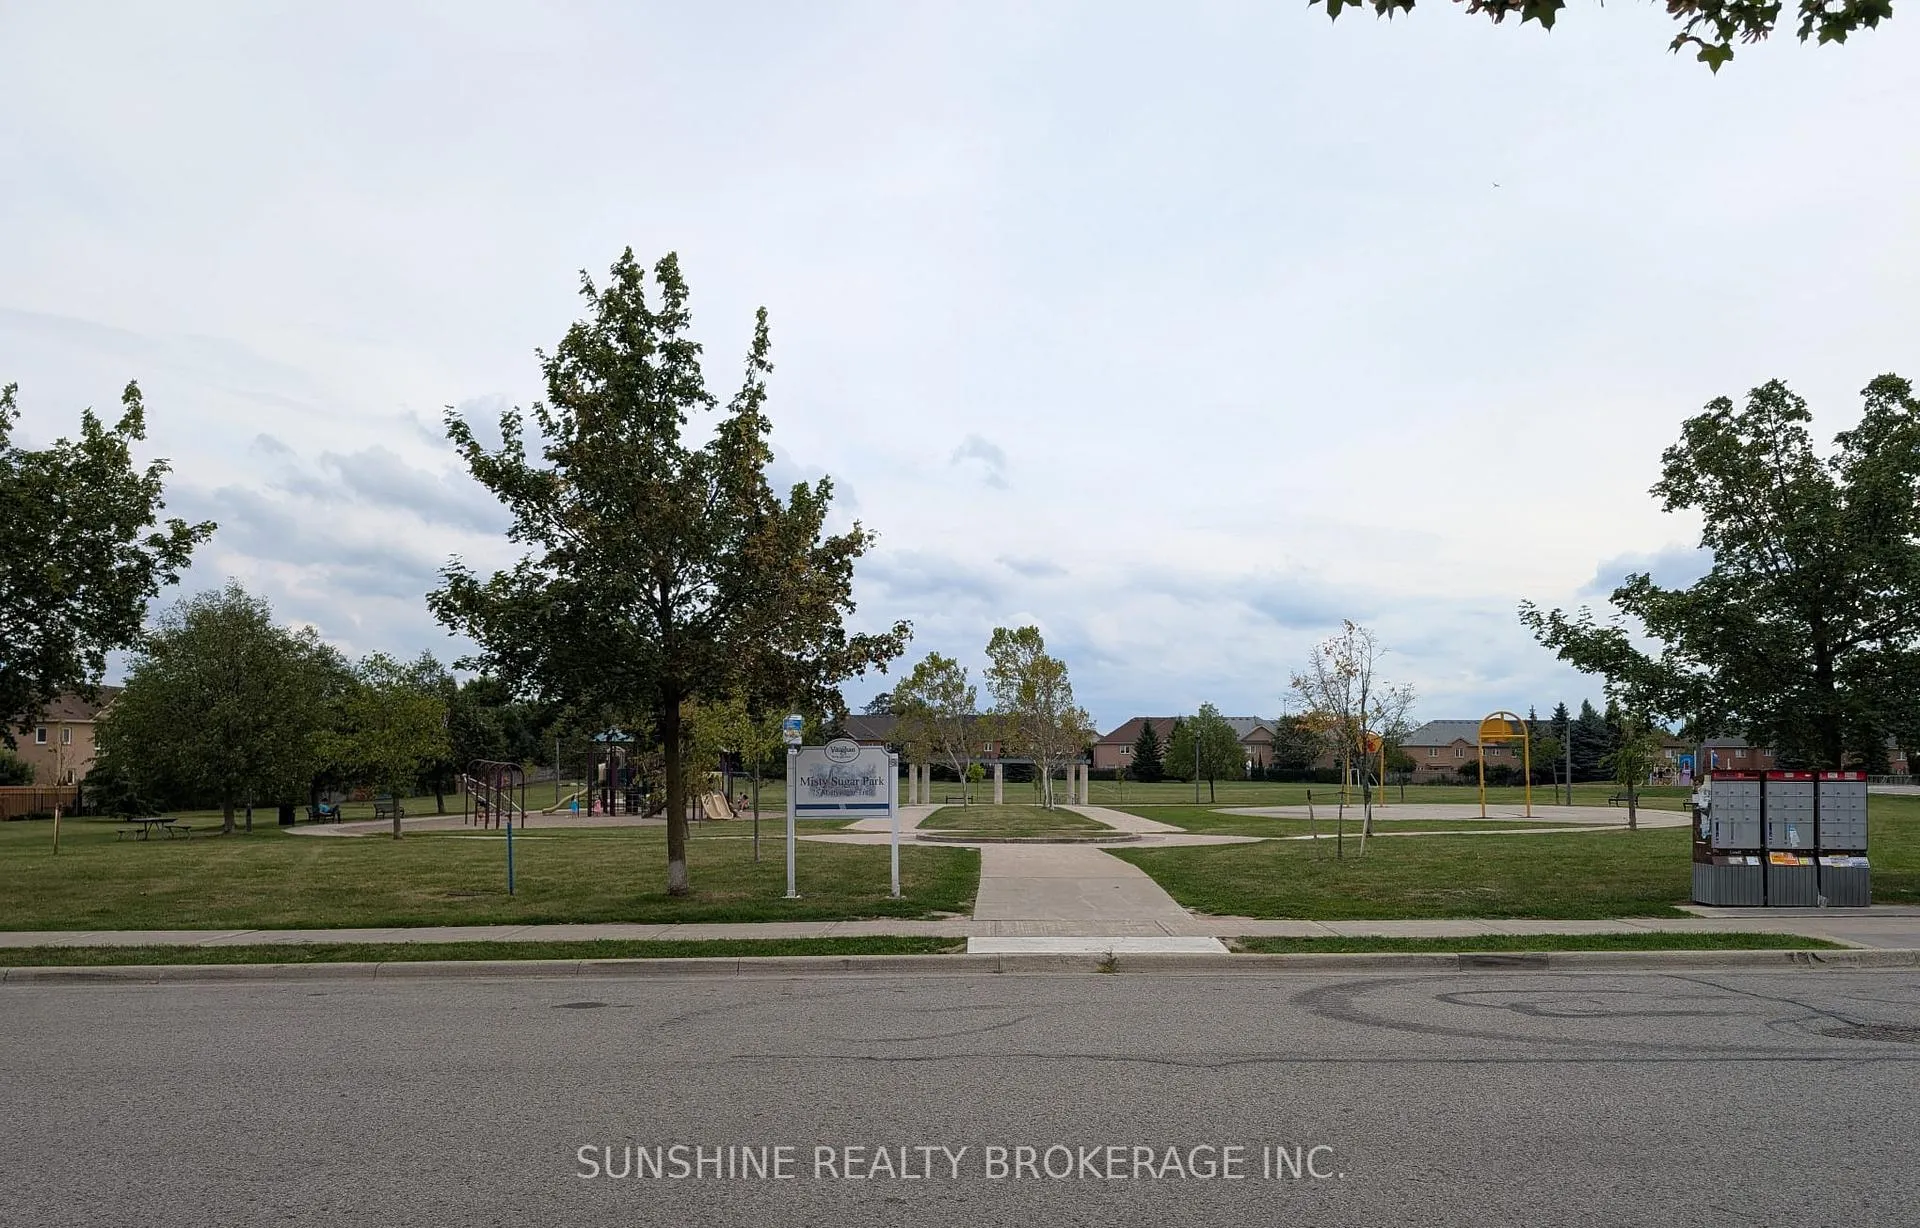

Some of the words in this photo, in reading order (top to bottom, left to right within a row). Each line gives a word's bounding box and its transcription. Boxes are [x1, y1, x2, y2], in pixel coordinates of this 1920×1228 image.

[830, 745, 856, 755] Vaughan
[800, 776, 828, 788] Misty
[831, 776, 859, 788] Sugar
[863, 776, 885, 787] Park
